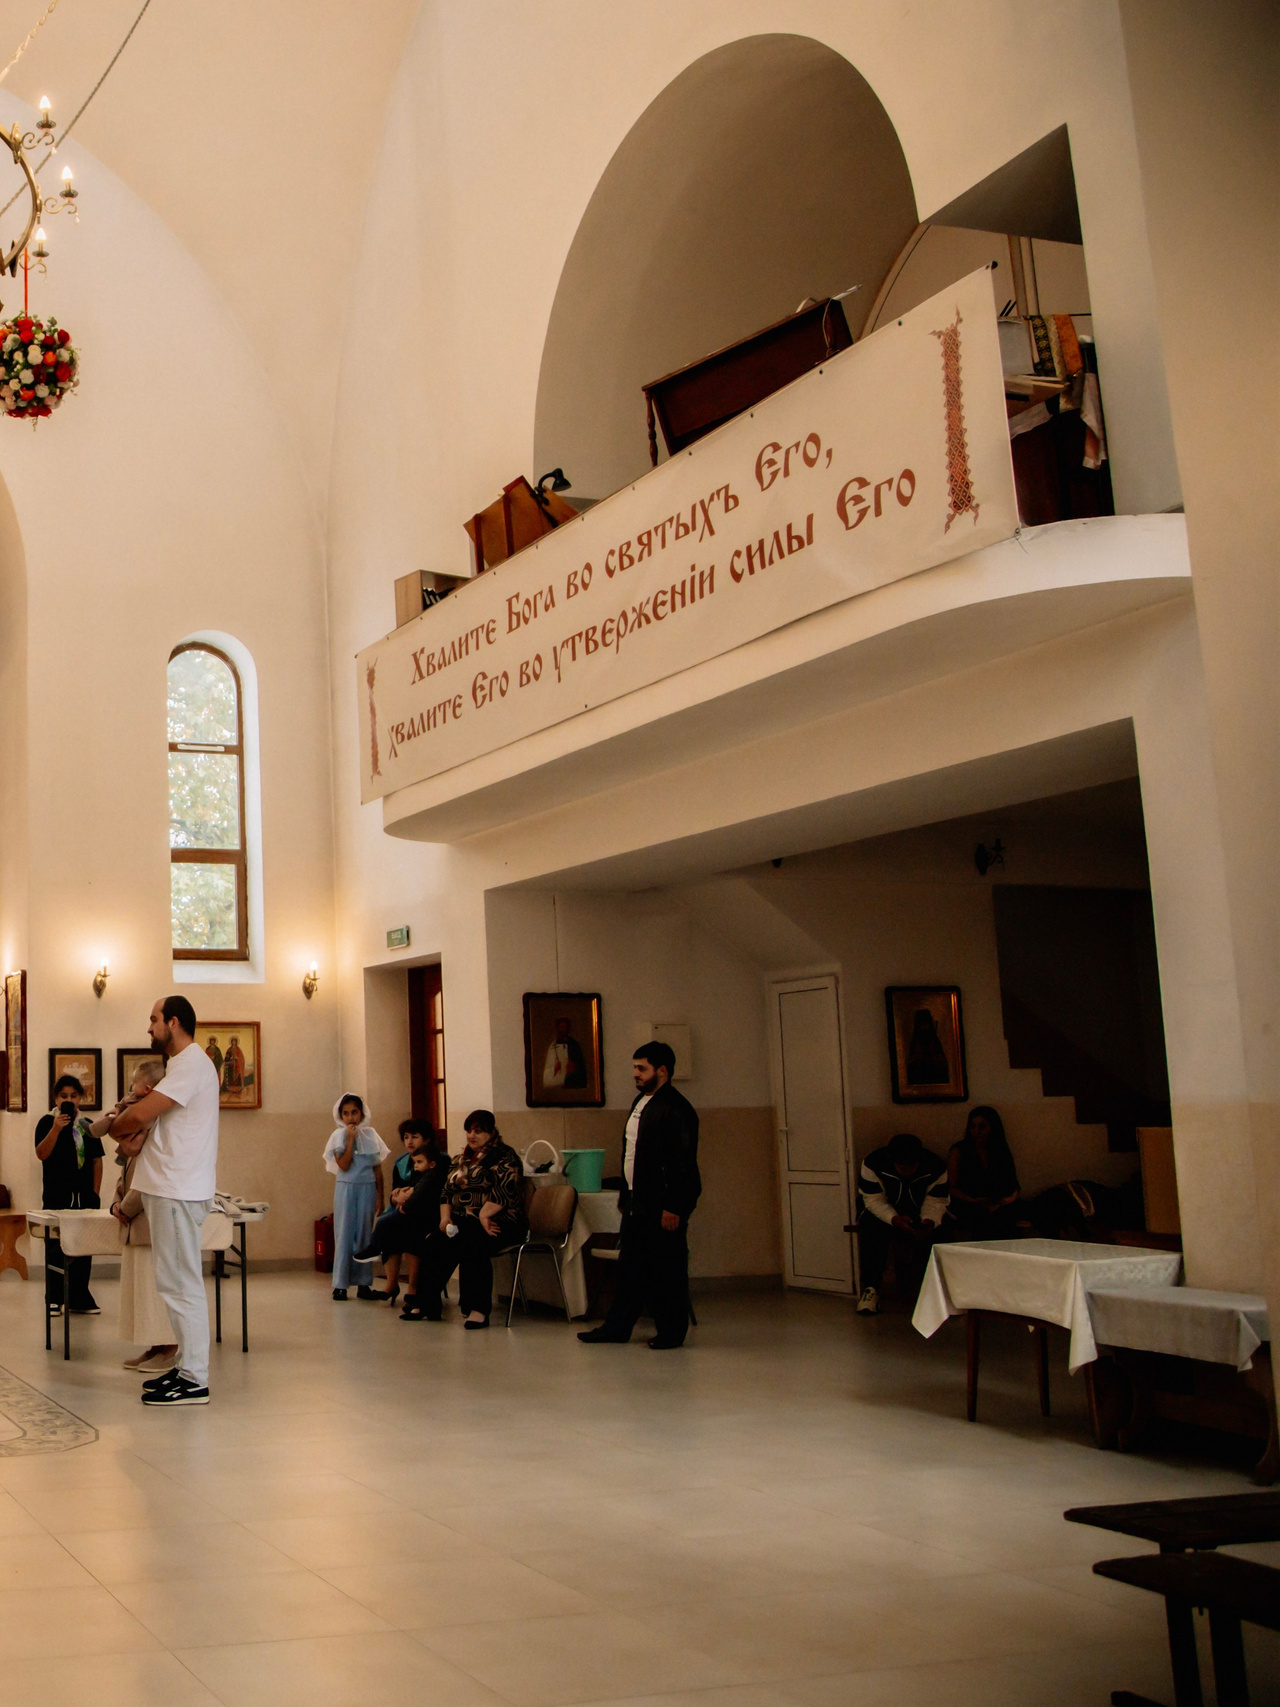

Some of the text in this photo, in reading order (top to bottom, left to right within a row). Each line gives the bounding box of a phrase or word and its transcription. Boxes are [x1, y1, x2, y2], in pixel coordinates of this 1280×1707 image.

[506, 585, 556, 635] Бога
[567, 562, 593, 600] во
[605, 483, 740, 578] святыхъ
[519, 653, 543, 689] во
[729, 513, 815, 584] силы
